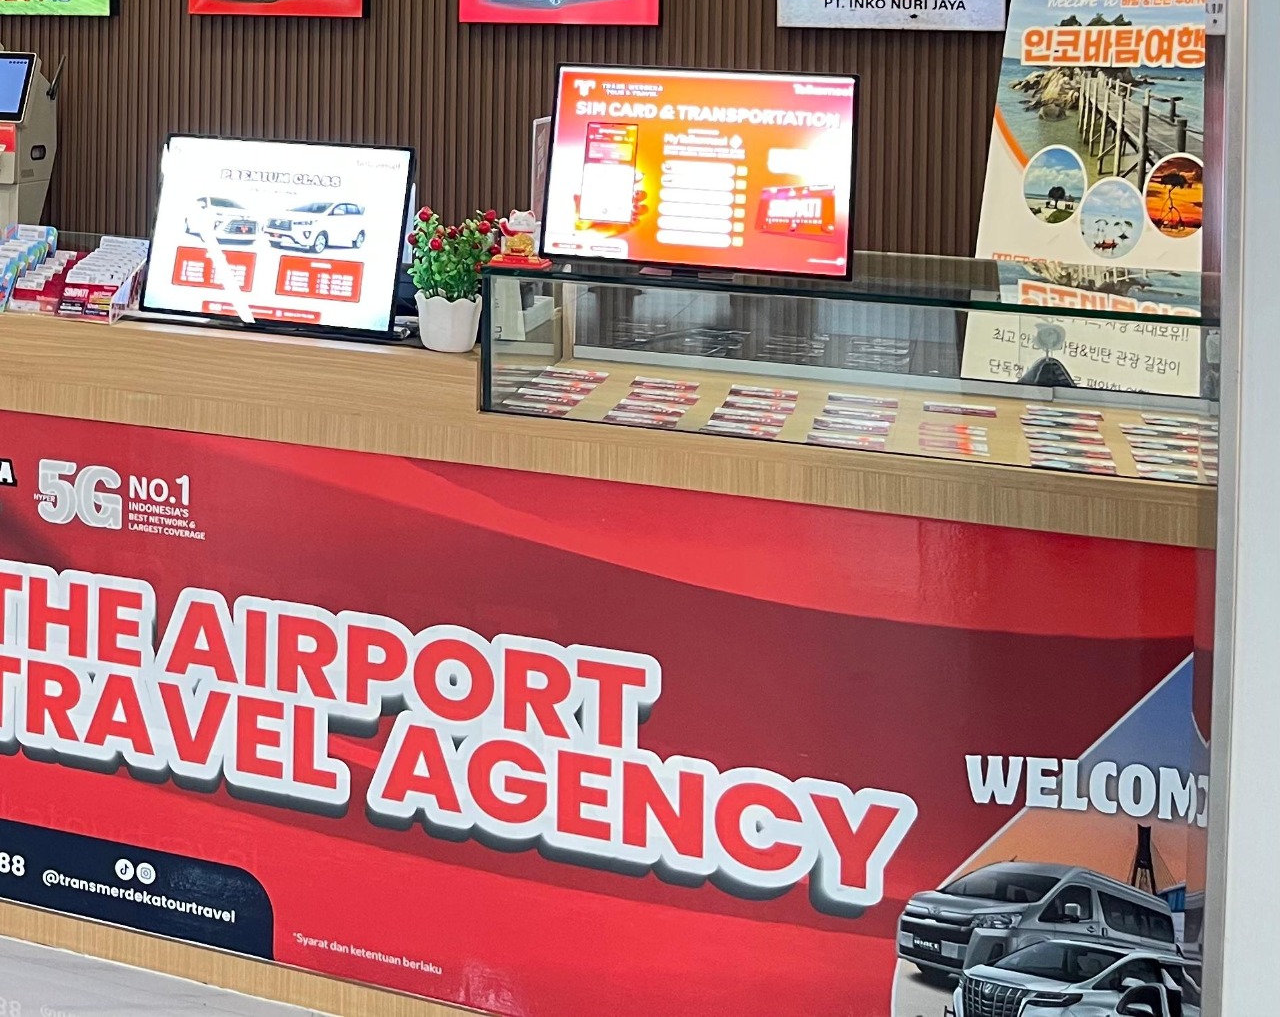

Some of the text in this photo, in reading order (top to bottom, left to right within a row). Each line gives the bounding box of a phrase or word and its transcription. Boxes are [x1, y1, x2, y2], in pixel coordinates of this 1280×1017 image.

[891, 0, 928, 10] NURI
[932, 0, 966, 11] JAYA
[1023, 26, 1206, 66] 인코바탐여행
[576, 101, 840, 129] SIM CARD & TRANSPORTATION
[221, 168, 290, 184] PREMIUM
[34, 493, 56, 503] HYPER
[38, 458, 190, 530] 5G NO.1
[128, 501, 189, 518] INDONESIA'S
[128, 513, 196, 529] BEST NETWORK &
[128, 522, 206, 541] LARGEST COVERAGE
[163, 594, 649, 751] AIRPORT
[378, 723, 903, 891] AGENCY
[42, 869, 236, 923] @transmerdekatourtravel
[329, 940, 349, 954] dan
[350, 944, 401, 965] ketentuan
[402, 956, 442, 975] berlaku
